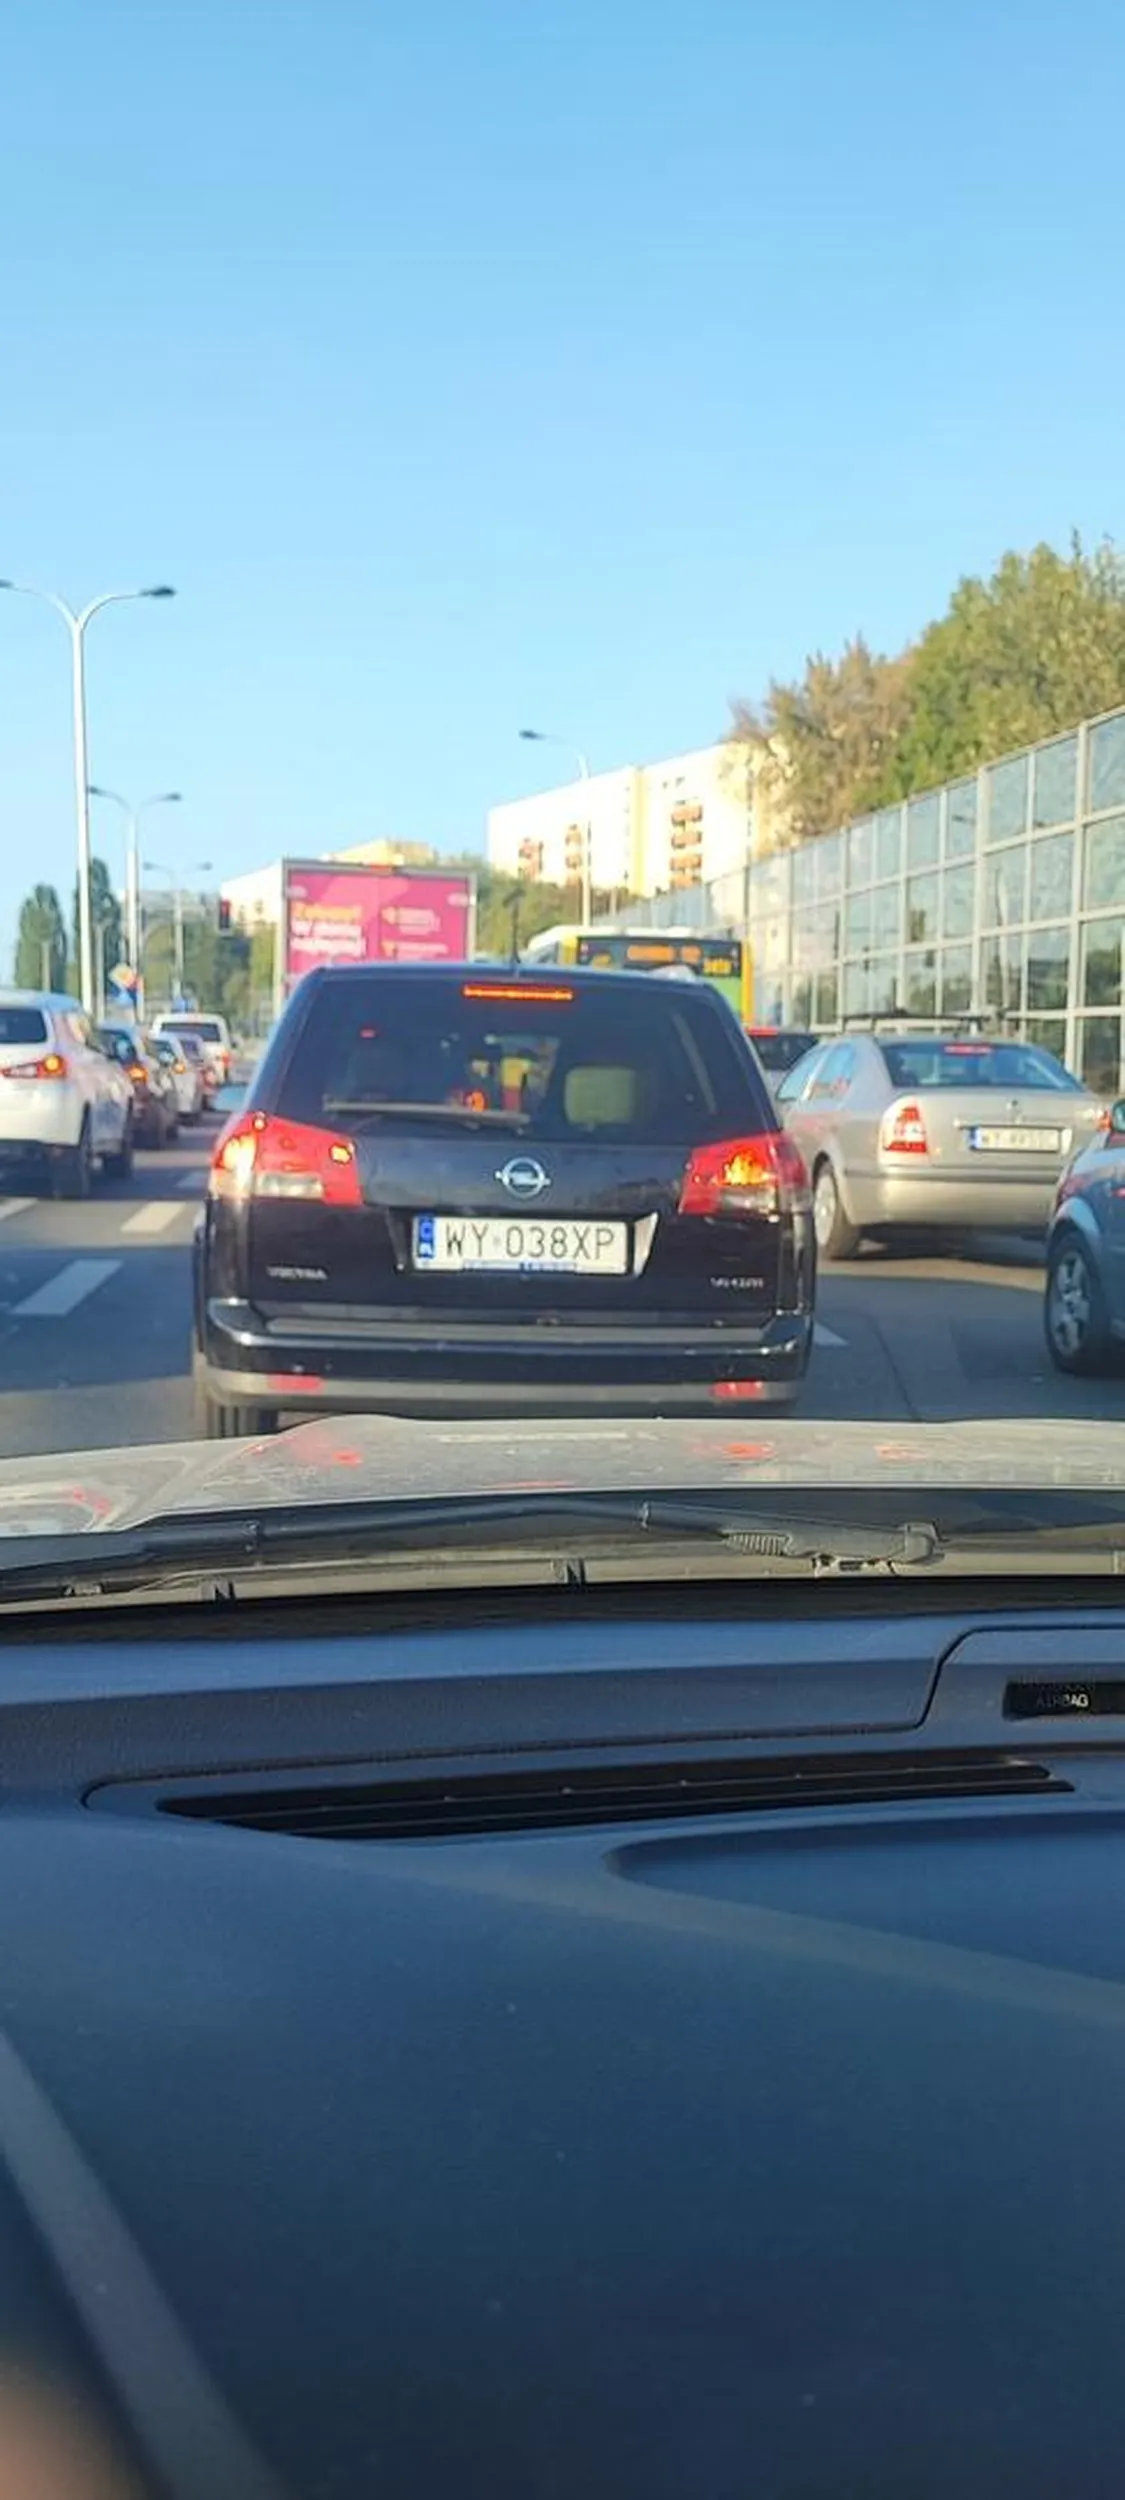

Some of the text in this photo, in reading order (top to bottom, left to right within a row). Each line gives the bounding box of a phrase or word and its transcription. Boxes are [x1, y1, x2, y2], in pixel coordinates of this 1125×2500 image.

[445, 1221, 489, 1258] WY
[506, 1225, 615, 1260] 038XP
[1037, 1693, 1089, 1708] AIRBAG
